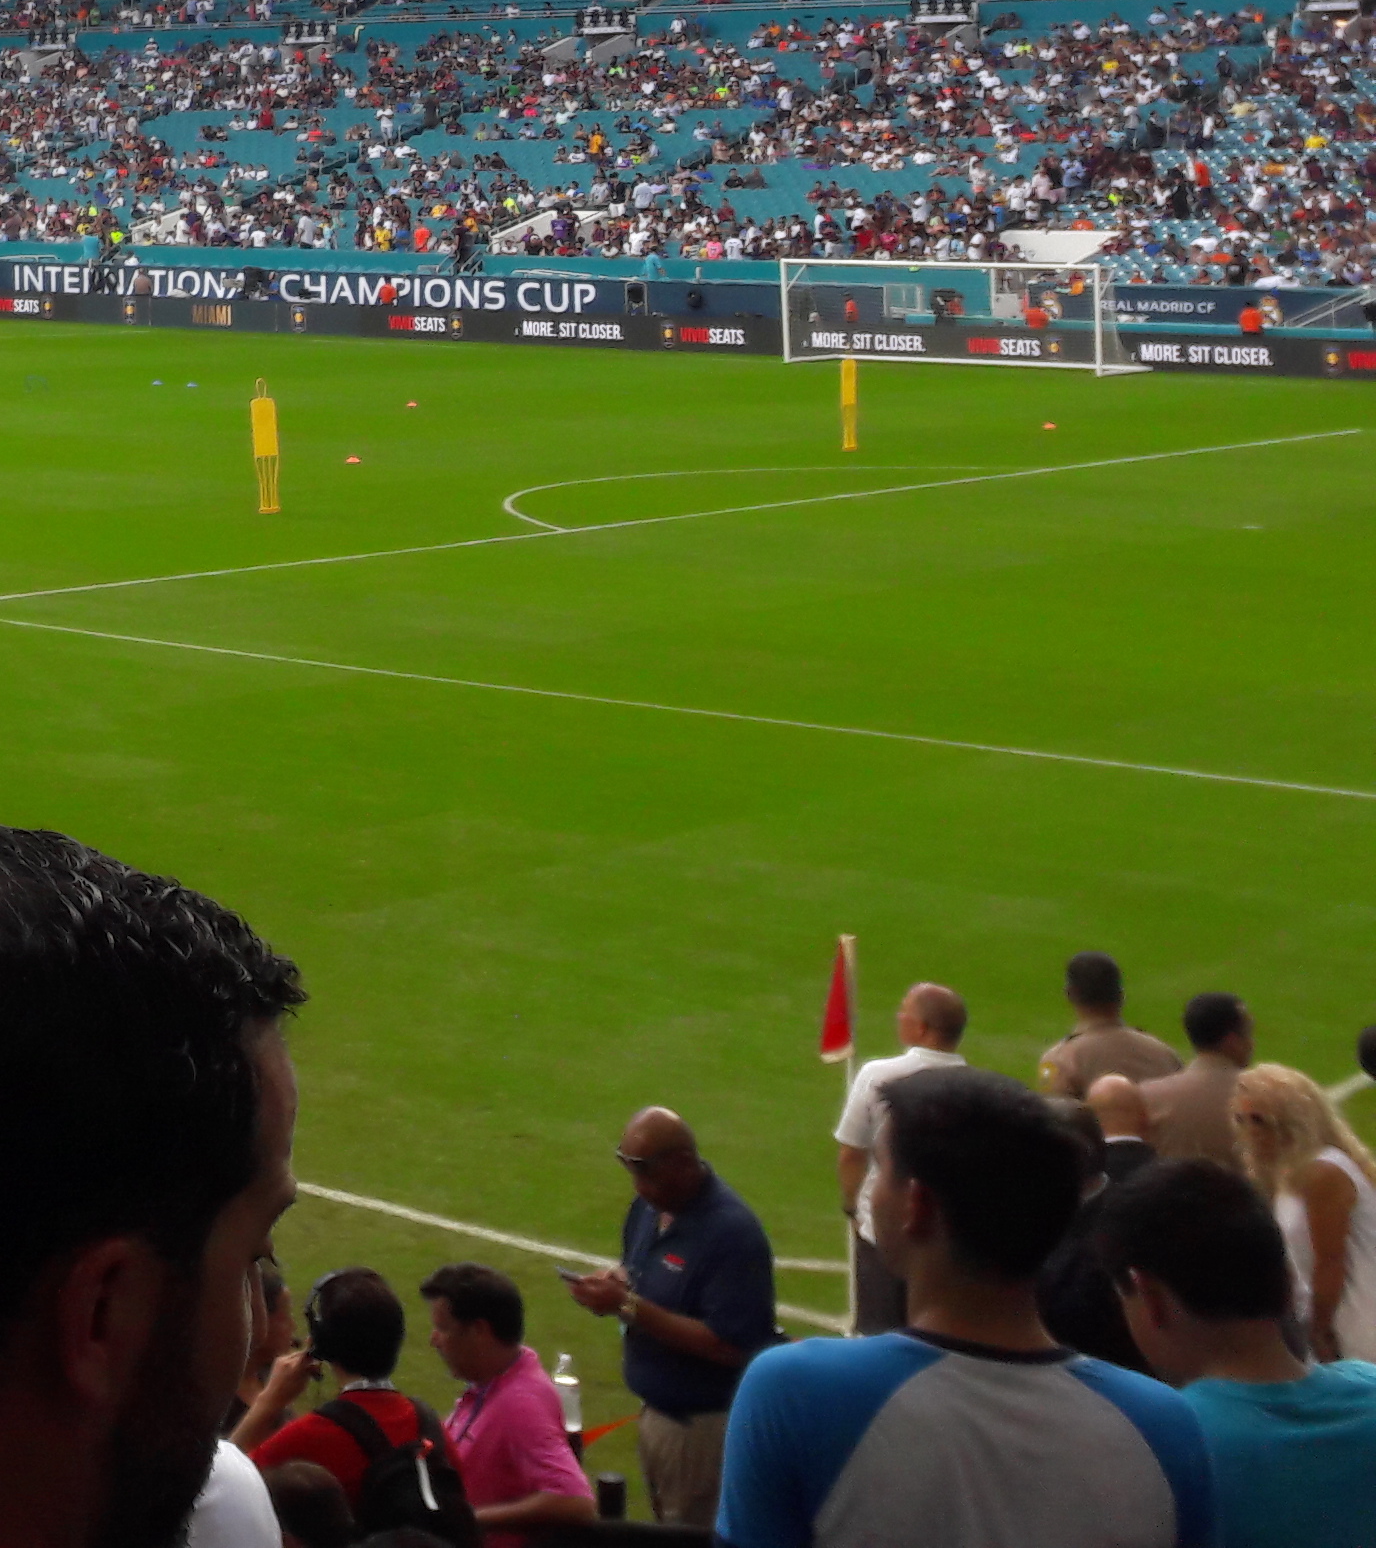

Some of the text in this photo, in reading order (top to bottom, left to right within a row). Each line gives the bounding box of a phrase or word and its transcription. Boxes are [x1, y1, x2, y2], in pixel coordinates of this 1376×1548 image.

[13, 299, 39, 313] SEATS
[517, 281, 597, 313] CUP
[414, 317, 446, 332] SEATS
[522, 320, 624, 340] MORE. SIT CLOSER.
[709, 328, 745, 345] SEATS
[812, 332, 926, 352] MORE. SIT CLOSER.
[1000, 339, 1041, 356] SEATS
[1141, 343, 1273, 366] MORE. SIT CLOSER.
